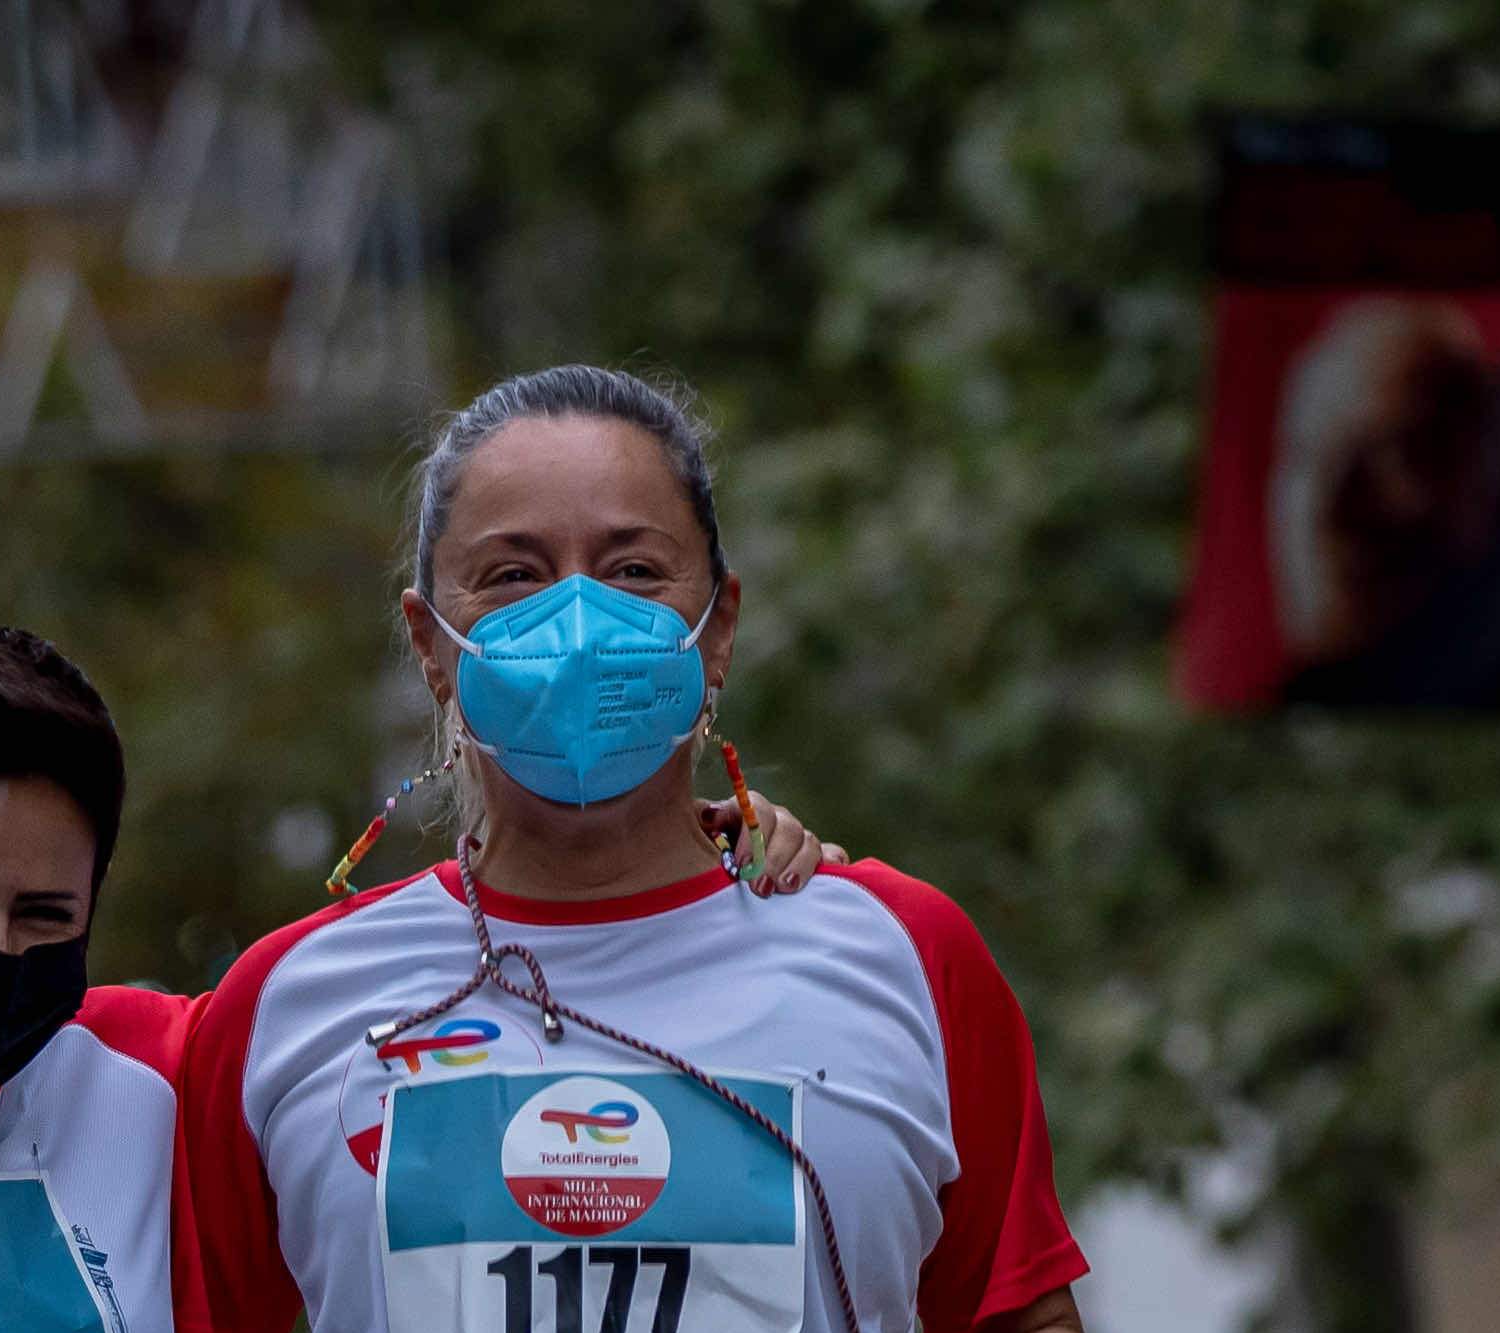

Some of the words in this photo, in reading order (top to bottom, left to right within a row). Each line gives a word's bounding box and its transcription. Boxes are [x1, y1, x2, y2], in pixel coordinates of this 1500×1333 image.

[539, 1151, 639, 1167] TotalEnergies
[563, 1180, 609, 1194] MILLA
[545, 1210, 565, 1223] DE
[569, 1209, 628, 1223] MADRID
